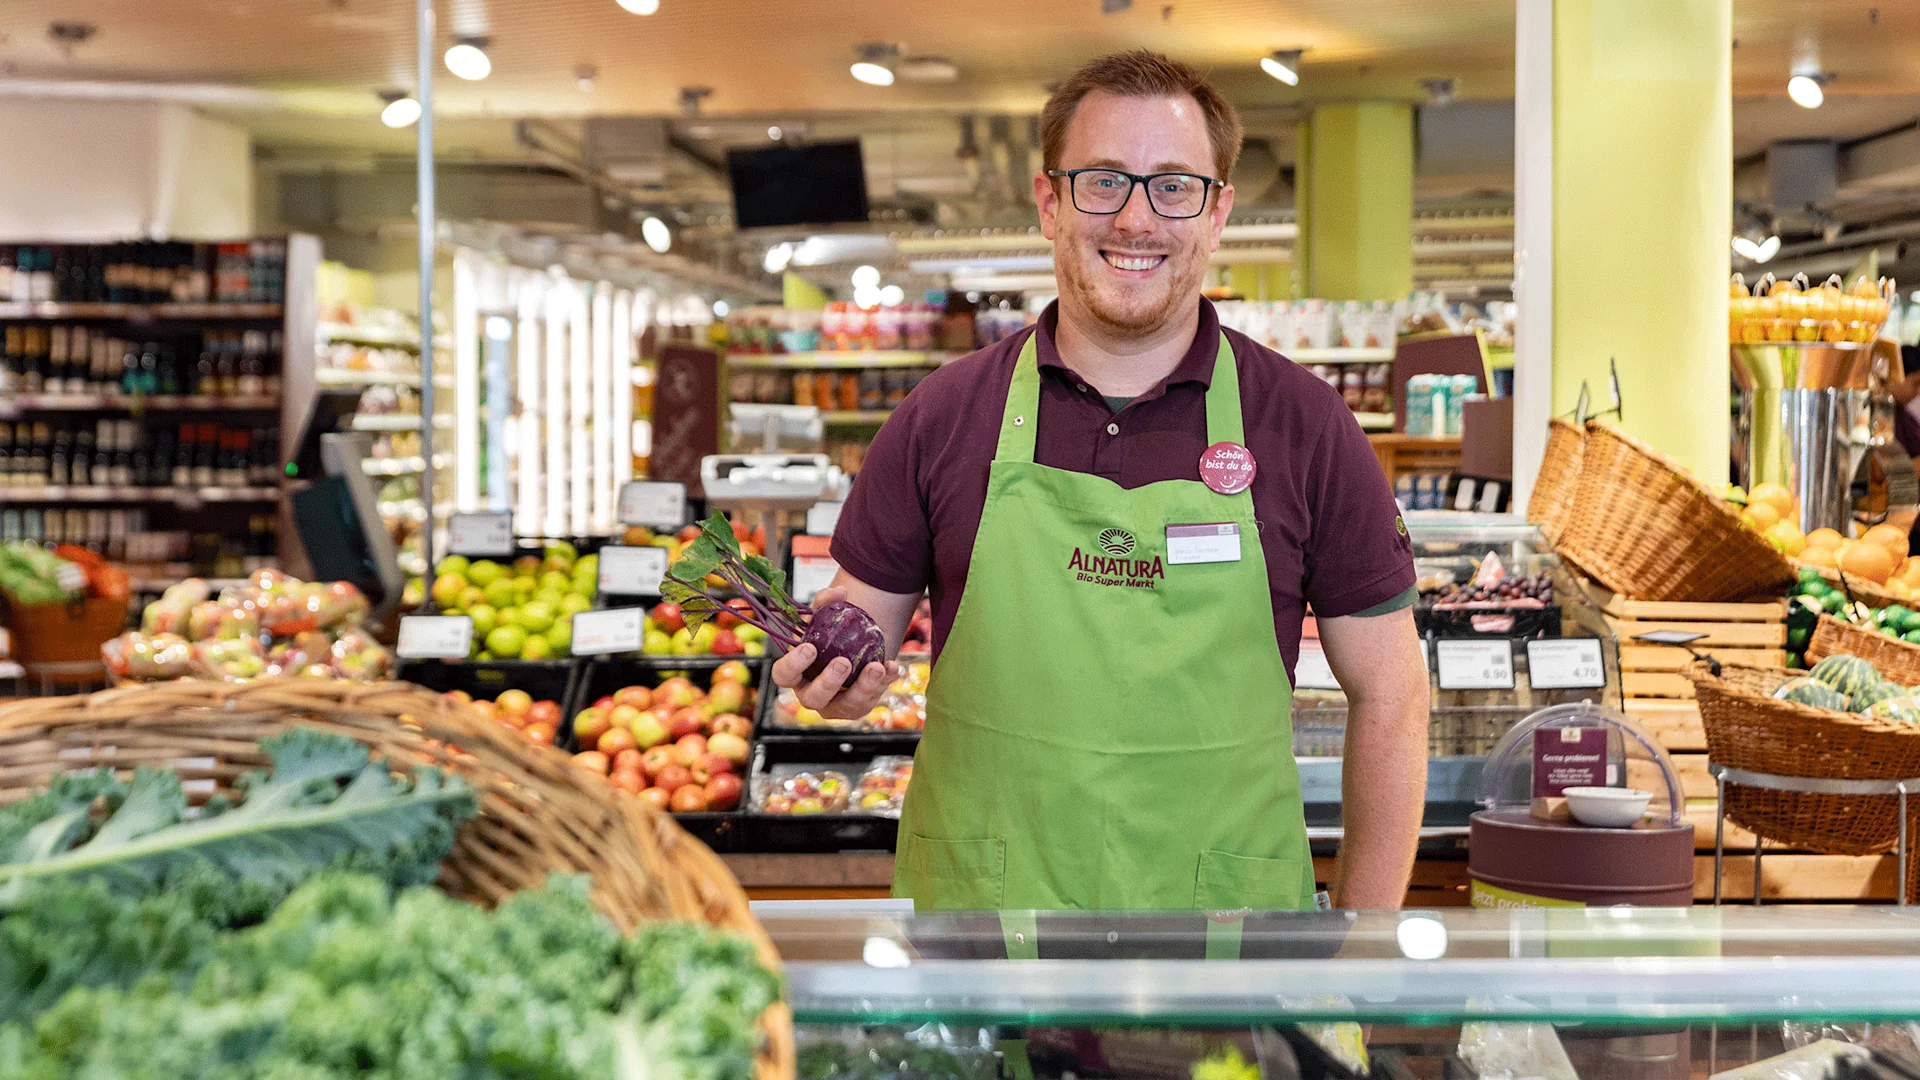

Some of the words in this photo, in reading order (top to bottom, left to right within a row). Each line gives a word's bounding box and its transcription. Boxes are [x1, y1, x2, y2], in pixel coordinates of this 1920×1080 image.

[1214, 448, 1244, 460] Schön
[1205, 458, 1225, 469] bist
[1226, 460, 1239, 470] du
[1240, 461, 1253, 471] da
[1067, 547, 1165, 580] ALNATURA
[1076, 572, 1093, 583] Bio
[1094, 574, 1125, 587] Super
[1125, 577, 1155, 589] Markt
